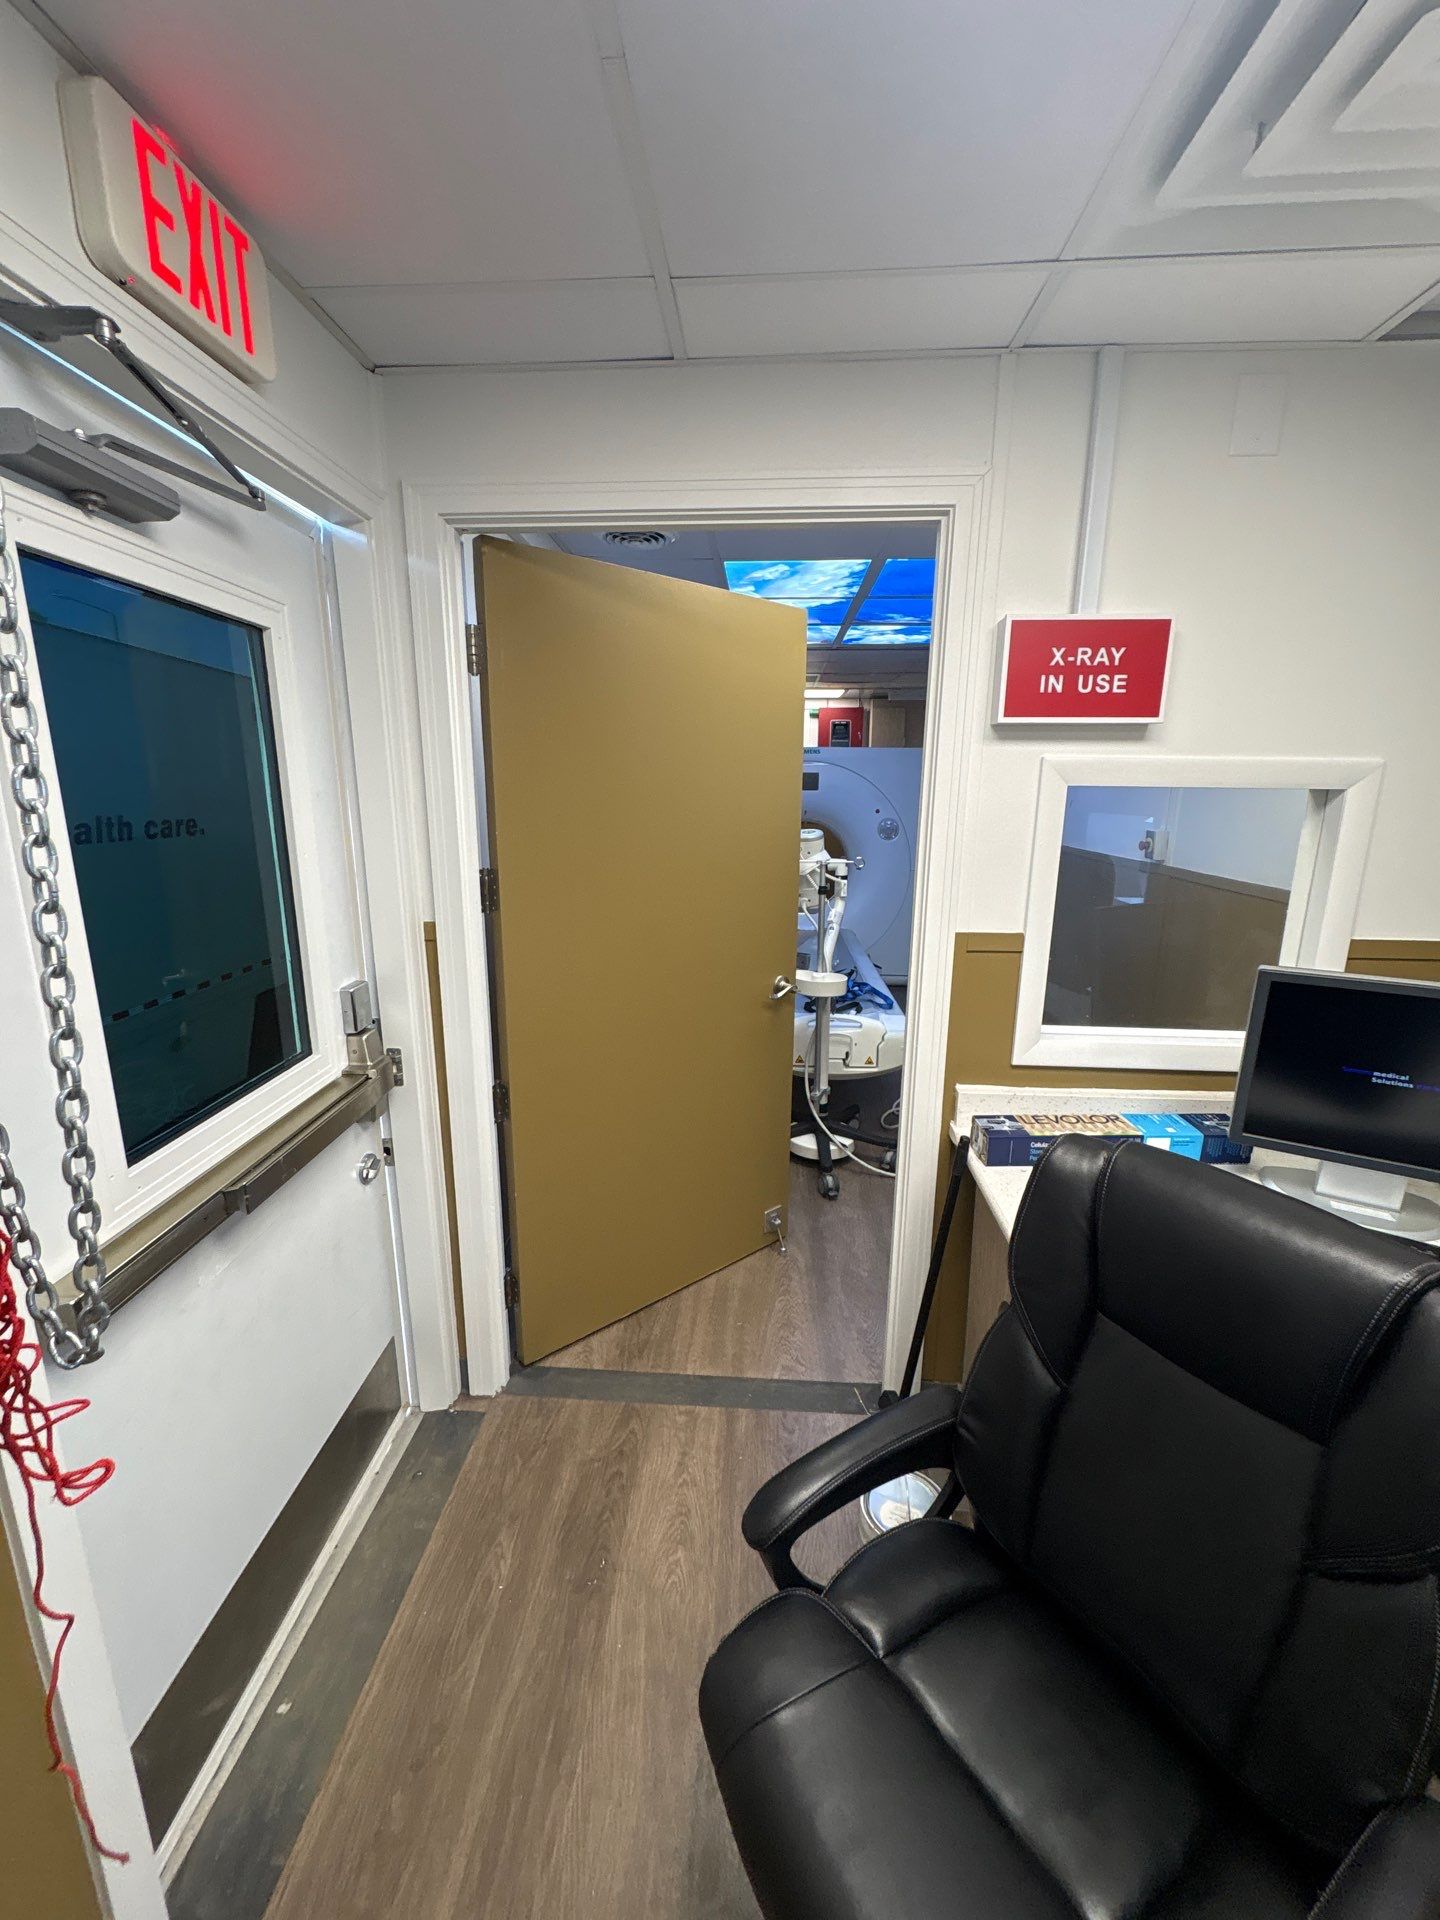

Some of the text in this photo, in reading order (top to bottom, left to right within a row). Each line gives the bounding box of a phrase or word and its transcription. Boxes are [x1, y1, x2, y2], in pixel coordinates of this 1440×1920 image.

[131, 117, 256, 356] EXIT
[1050, 647, 1127, 666] X-RAY
[1039, 674, 1128, 694] IN USE
[144, 818, 205, 840] care.
[1371, 1076, 1414, 1088] Solutions
[1373, 1071, 1410, 1081] medical
[1018, 1114, 1125, 1125] LEVOLOR
